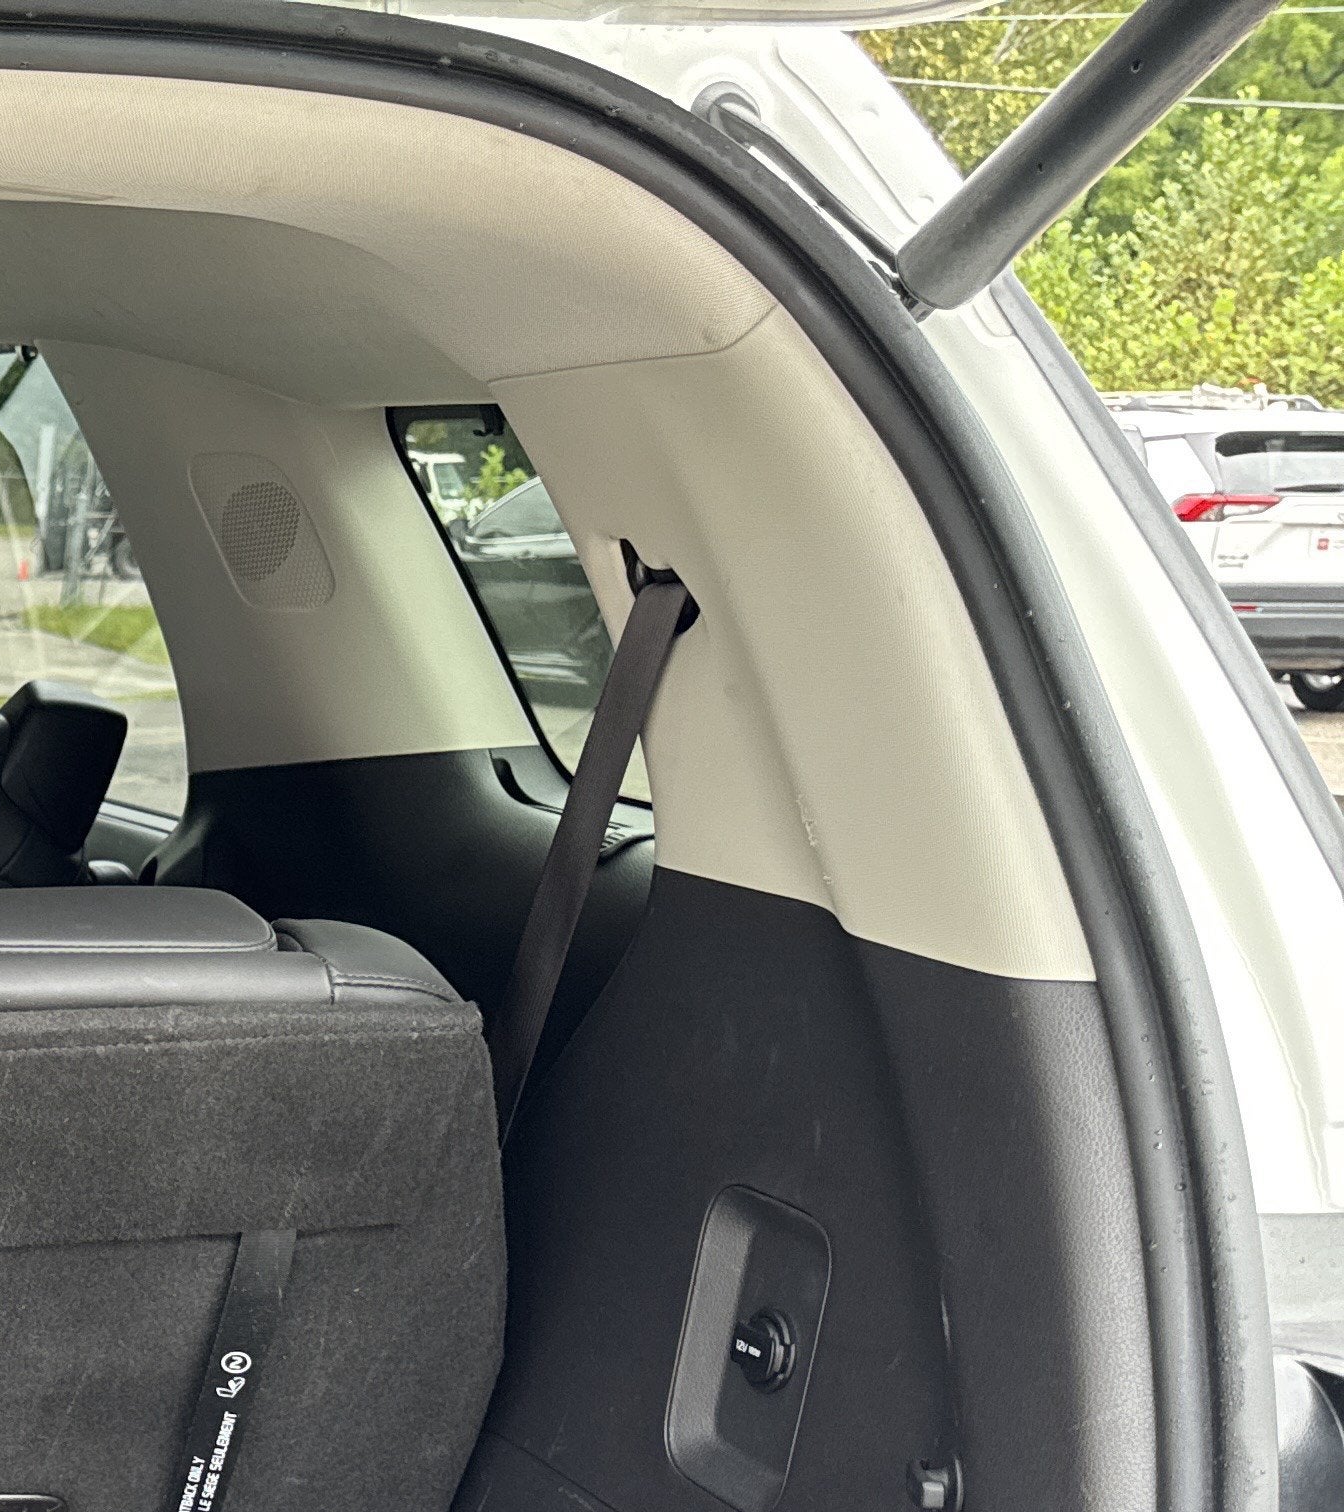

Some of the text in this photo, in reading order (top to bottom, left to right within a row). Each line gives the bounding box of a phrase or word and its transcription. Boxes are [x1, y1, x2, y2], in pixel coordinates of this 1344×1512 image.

[188, 1456, 205, 1483] ONLY
[198, 1499, 212, 1512] LE
[209, 1411, 237, 1471] SEULEMENT
